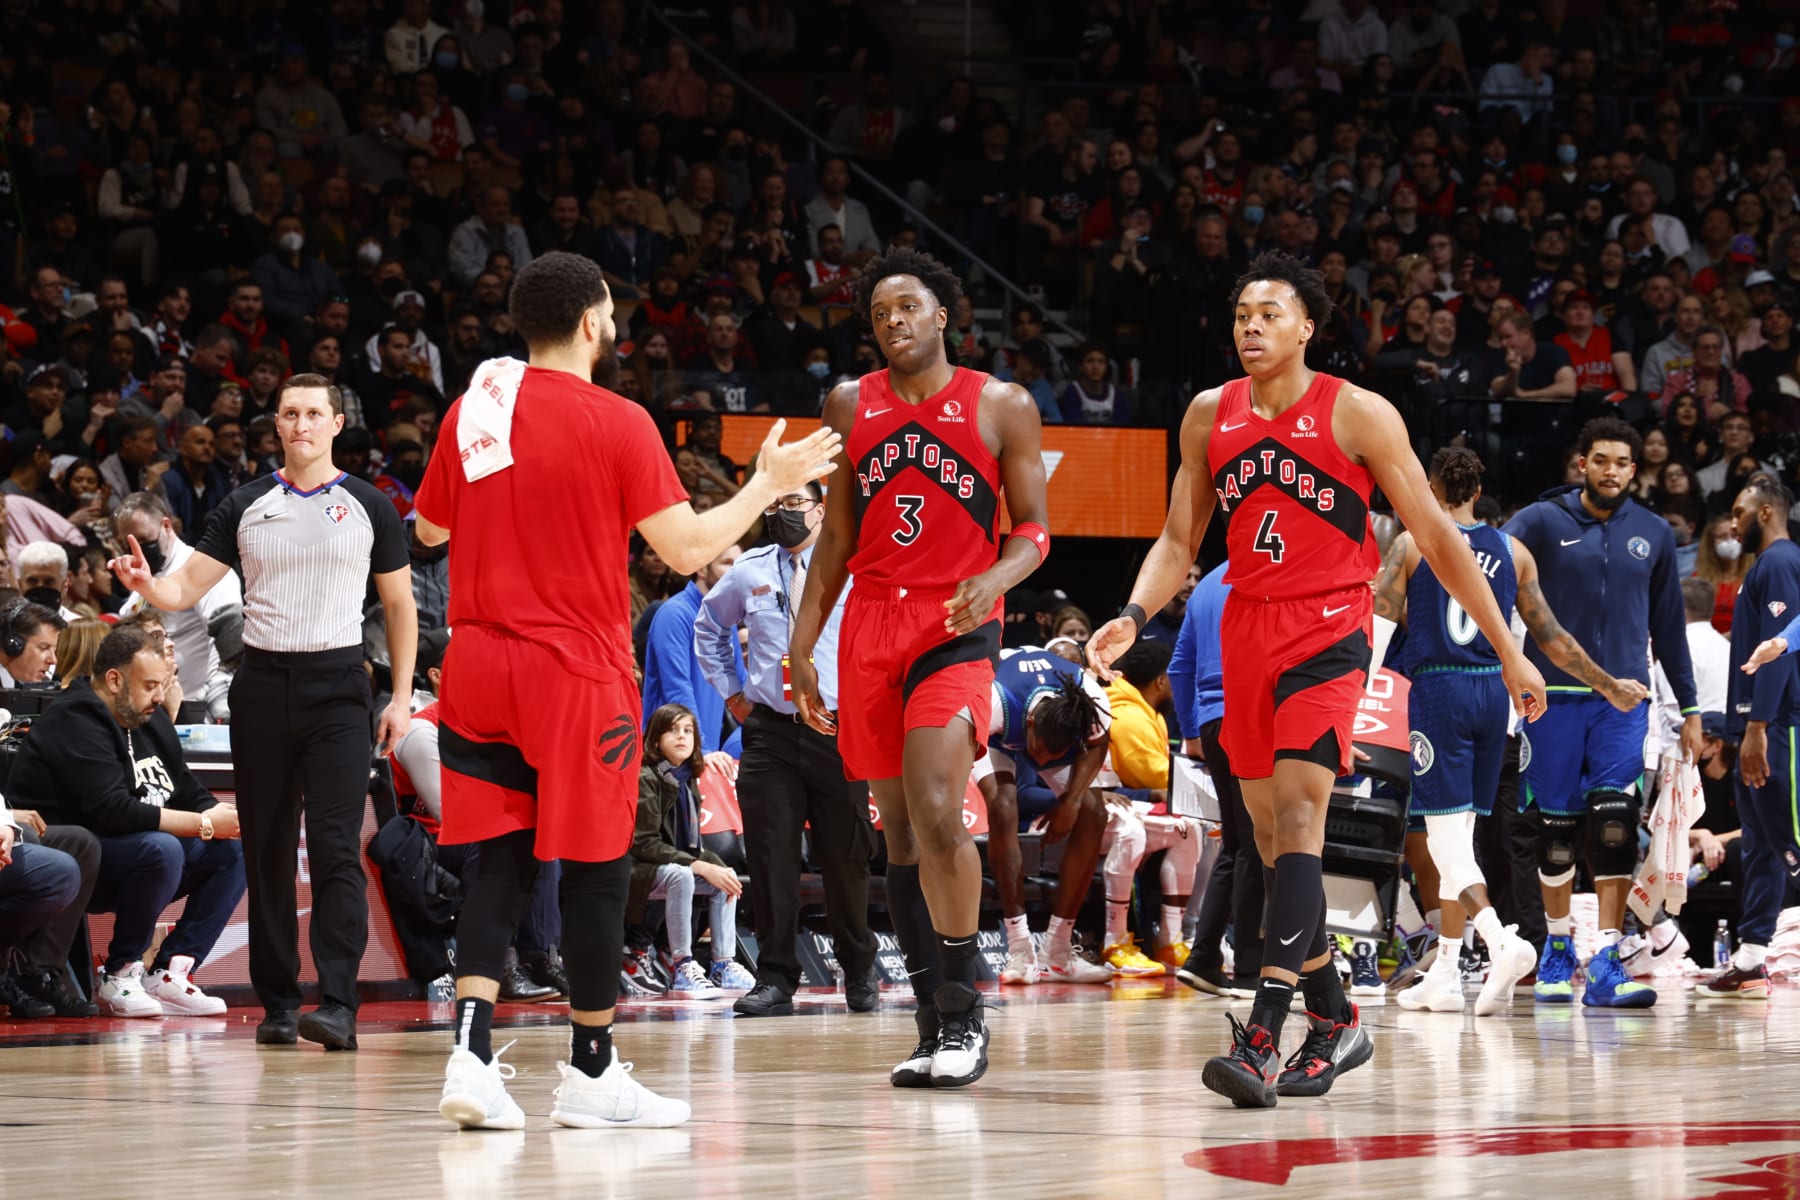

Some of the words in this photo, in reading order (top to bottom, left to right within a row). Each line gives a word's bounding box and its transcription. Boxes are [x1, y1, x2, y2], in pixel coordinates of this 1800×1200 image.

[858, 434, 974, 498] RAPTORS
[1216, 450, 1334, 511] RAPTORS
[891, 495, 924, 546] 3
[1253, 511, 1285, 563] 4
[1476, 551, 1502, 578] ELL
[1447, 596, 1479, 646] 0
